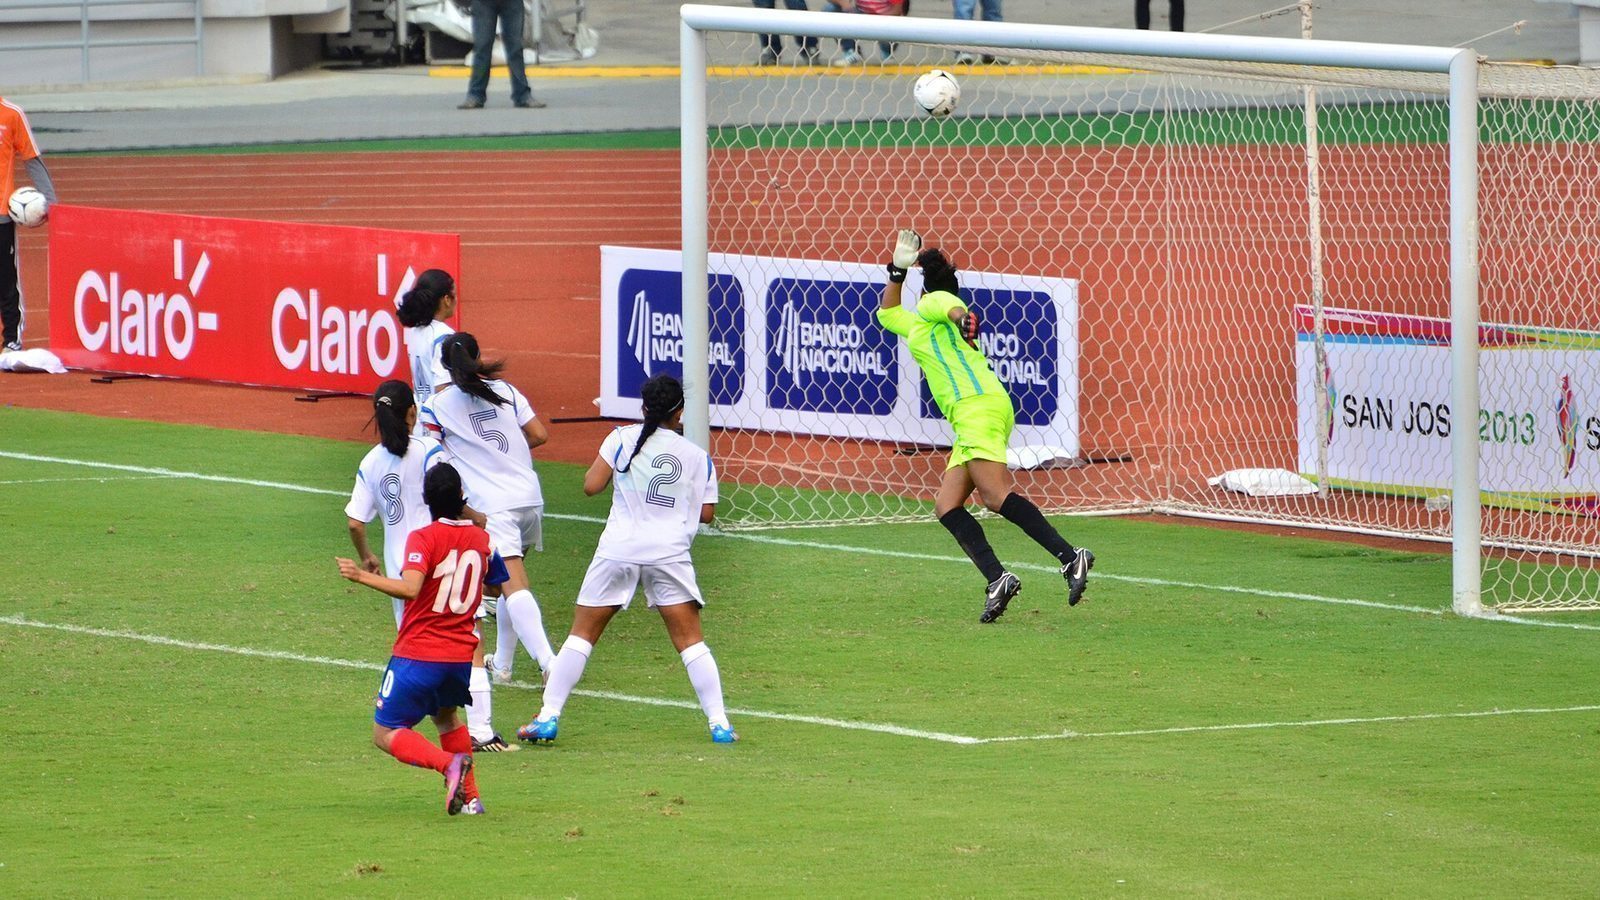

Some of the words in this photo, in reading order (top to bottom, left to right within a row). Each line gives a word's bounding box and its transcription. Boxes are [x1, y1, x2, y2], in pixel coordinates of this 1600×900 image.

[74, 270, 194, 360] Claro
[271, 287, 399, 378] Claro
[651, 312, 683, 337] BAN
[800, 322, 861, 348] BANCO
[800, 348, 888, 375] NACIONAL
[980, 332, 1019, 357] NCO
[987, 358, 1047, 386] IONAL
[469, 408, 509, 455] 5
[1342, 394, 1393, 431] SAN
[1402, 401, 1451, 437] JOS
[1478, 409, 1536, 446] 2013
[380, 473, 405, 526] 8
[646, 453, 683, 508] 2
[432, 549, 482, 615] 10
[378, 669, 394, 698] 0
